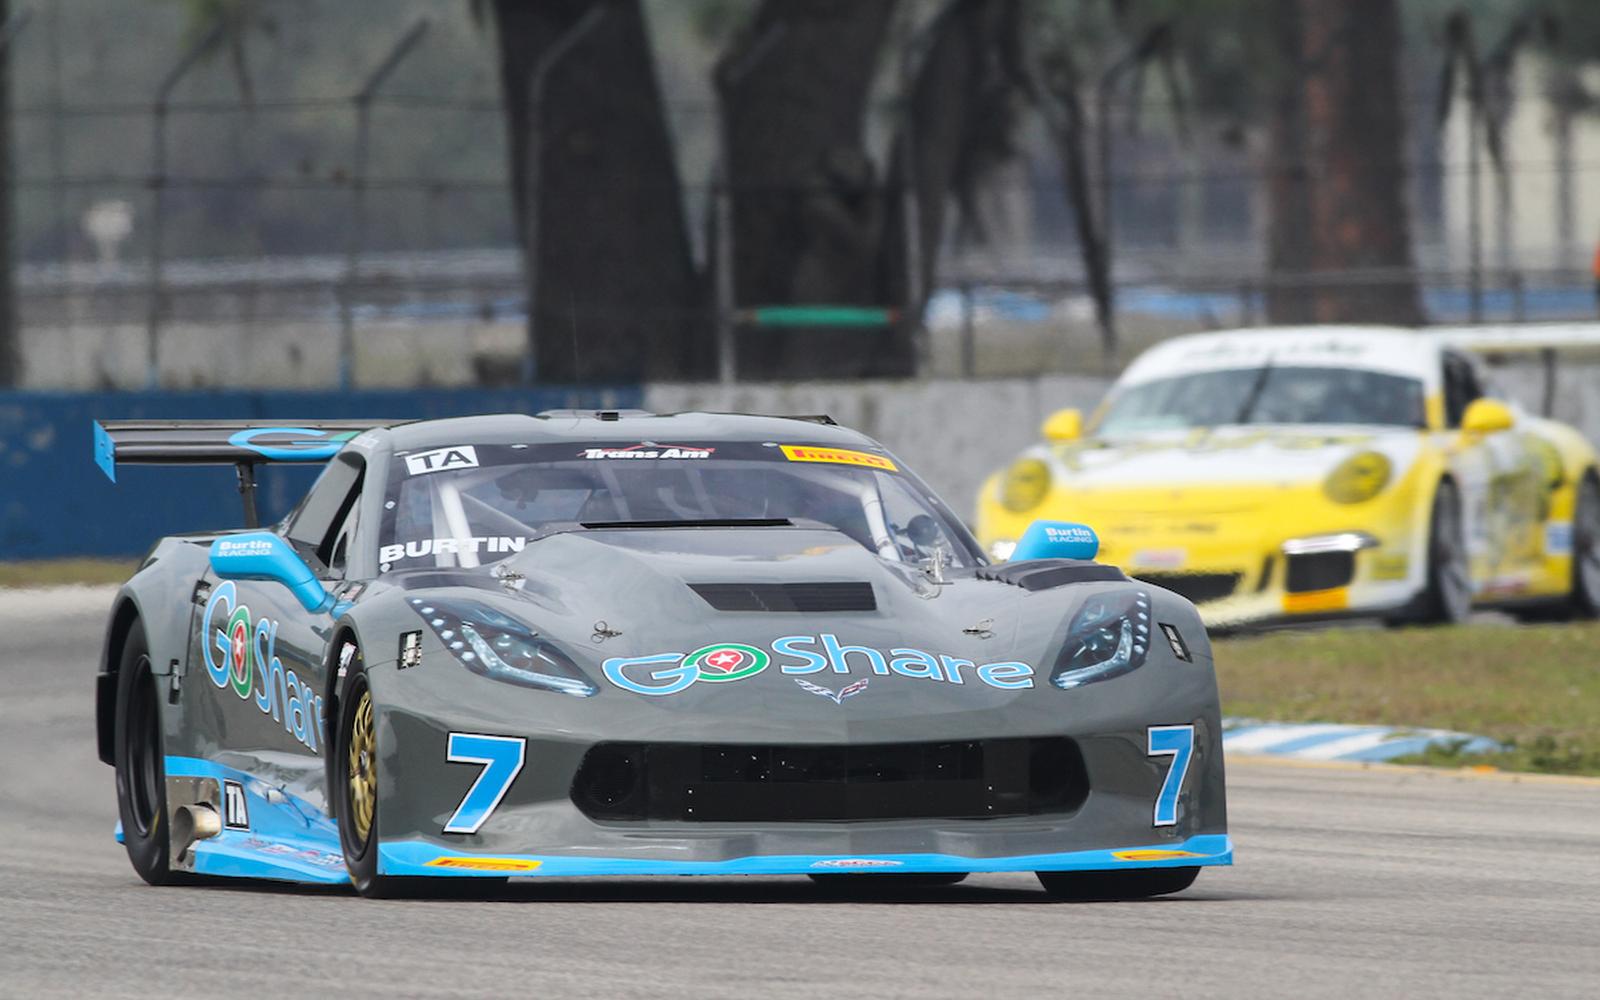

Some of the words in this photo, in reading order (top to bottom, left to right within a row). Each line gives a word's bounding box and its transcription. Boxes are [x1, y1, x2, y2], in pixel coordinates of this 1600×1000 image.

[411, 449, 473, 470] TA
[584, 448, 659, 459] Trans
[659, 448, 710, 459] Am
[1045, 527, 1092, 537] Burtin
[219, 541, 273, 551] Burtin
[379, 536, 526, 564] BURTIN
[443, 731, 527, 835] 7
[1147, 724, 1195, 828] 7
[226, 784, 248, 826] TA
